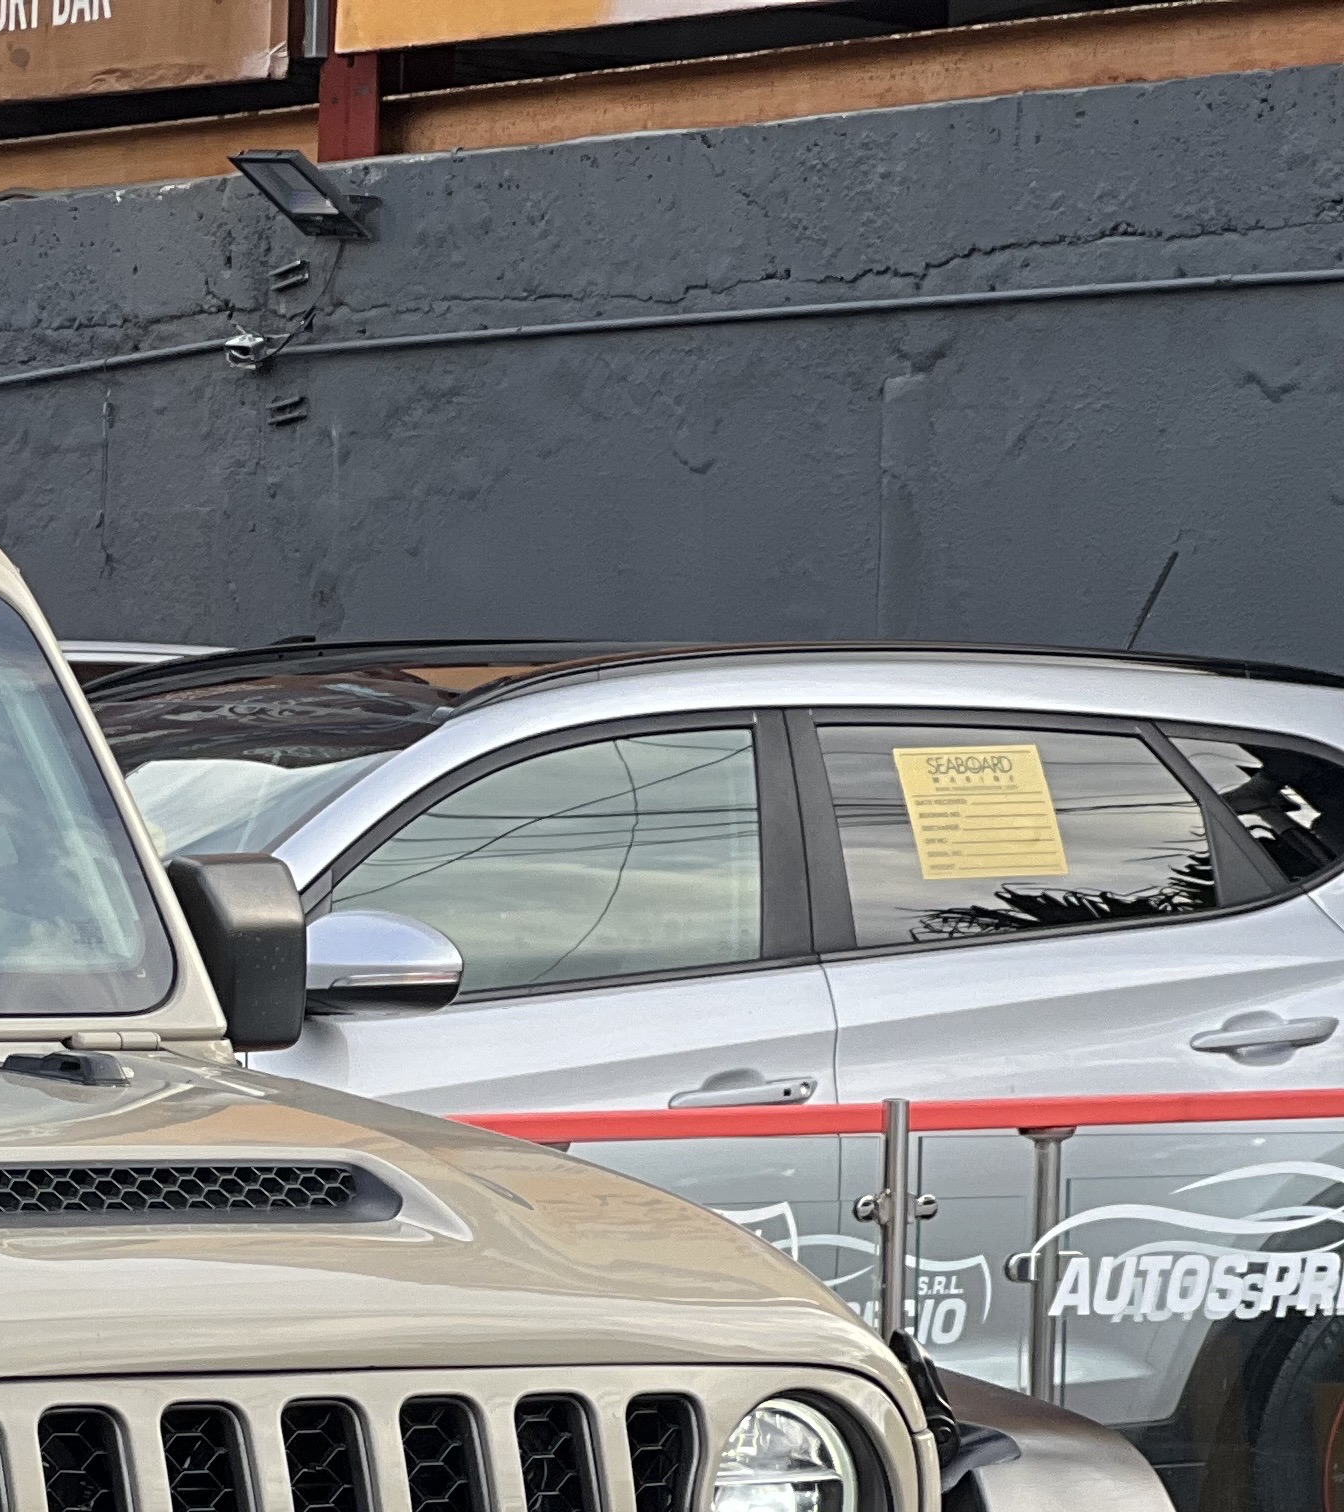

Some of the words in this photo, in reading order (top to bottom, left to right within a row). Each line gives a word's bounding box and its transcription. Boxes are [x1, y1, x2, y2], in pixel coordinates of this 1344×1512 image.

[926, 756, 1012, 775] SEABOARD
[917, 1276, 964, 1296] S.R.L.
[1259, 1252, 1344, 1318] PR
